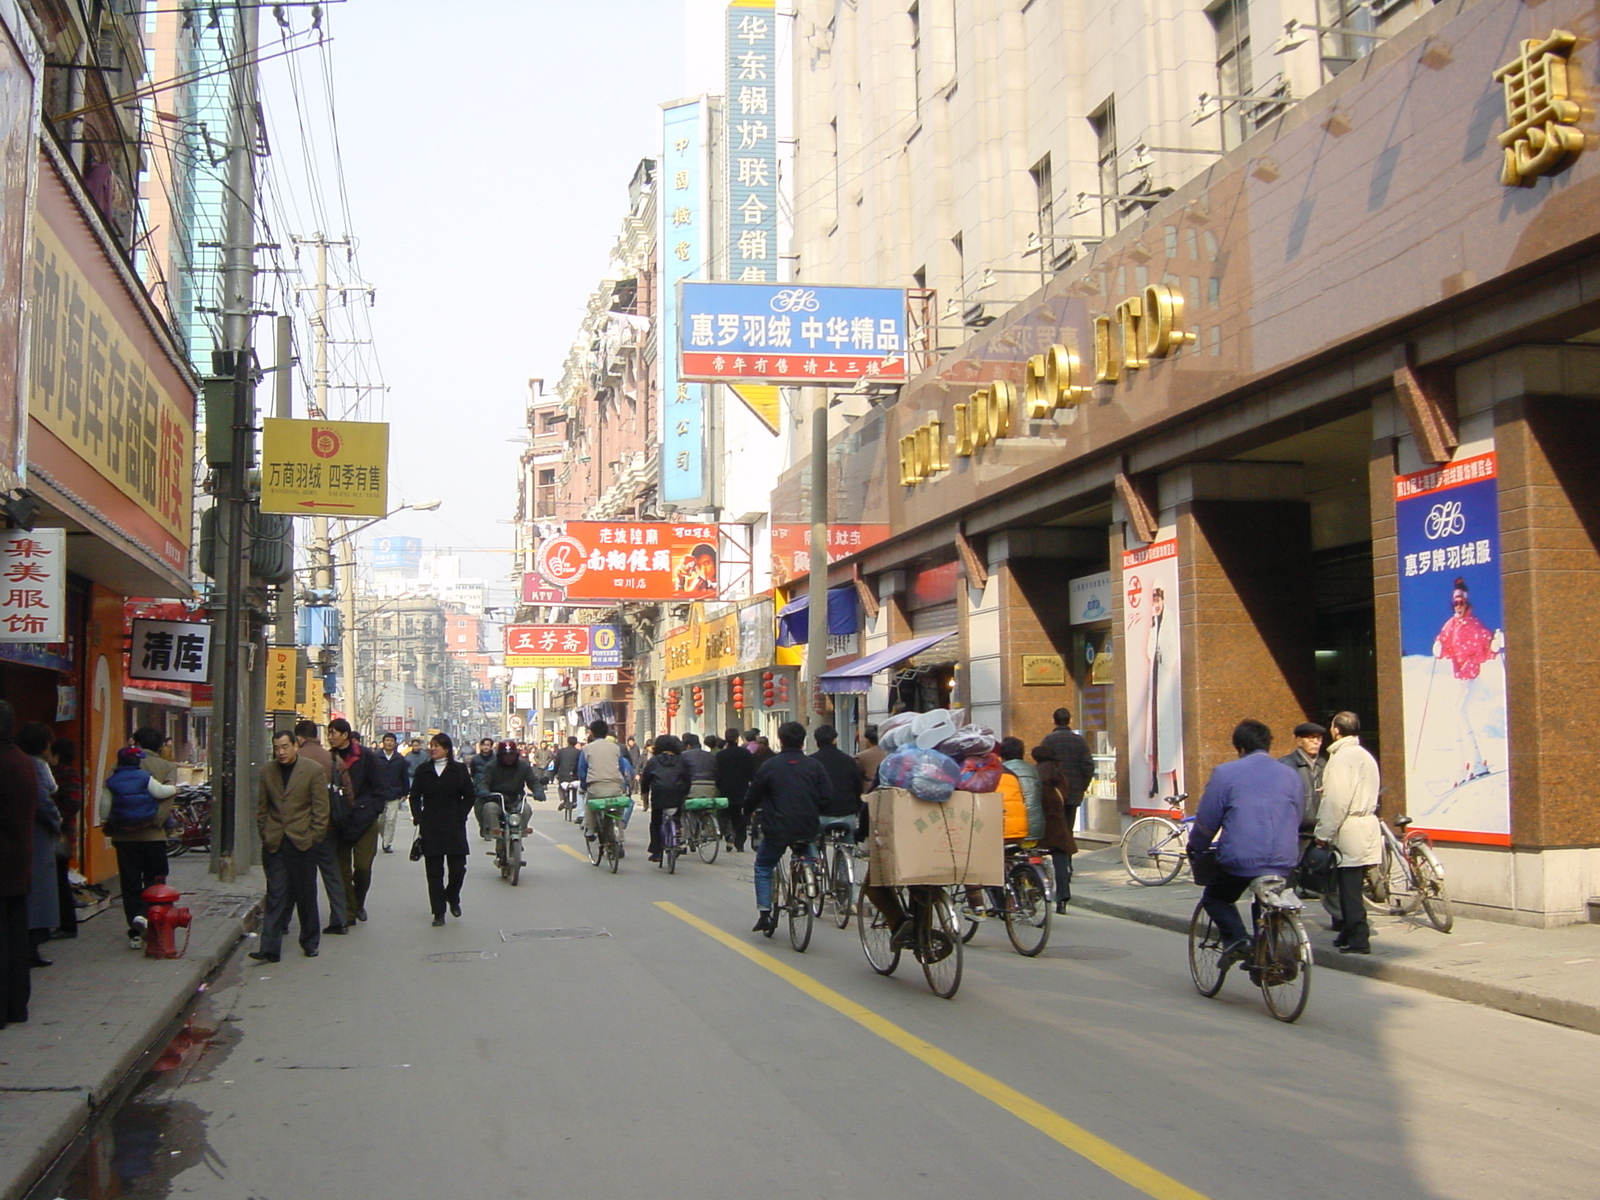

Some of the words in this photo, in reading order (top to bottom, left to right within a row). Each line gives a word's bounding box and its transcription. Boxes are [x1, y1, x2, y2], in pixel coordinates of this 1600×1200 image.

[1492, 29, 1584, 187] 惠
[690, 314, 792, 348] 惠罗羽绒
[800, 316, 900, 350] 中华精品
[269, 461, 322, 489] 万商羽绒
[328, 464, 381, 492] 四季有售
[1405, 540, 1491, 576] 惠罗牌羽绒服
[2, 538, 52, 634] 集美服饰
[141, 631, 205, 673] 清库
[514, 630, 582, 652] 五芳斋
